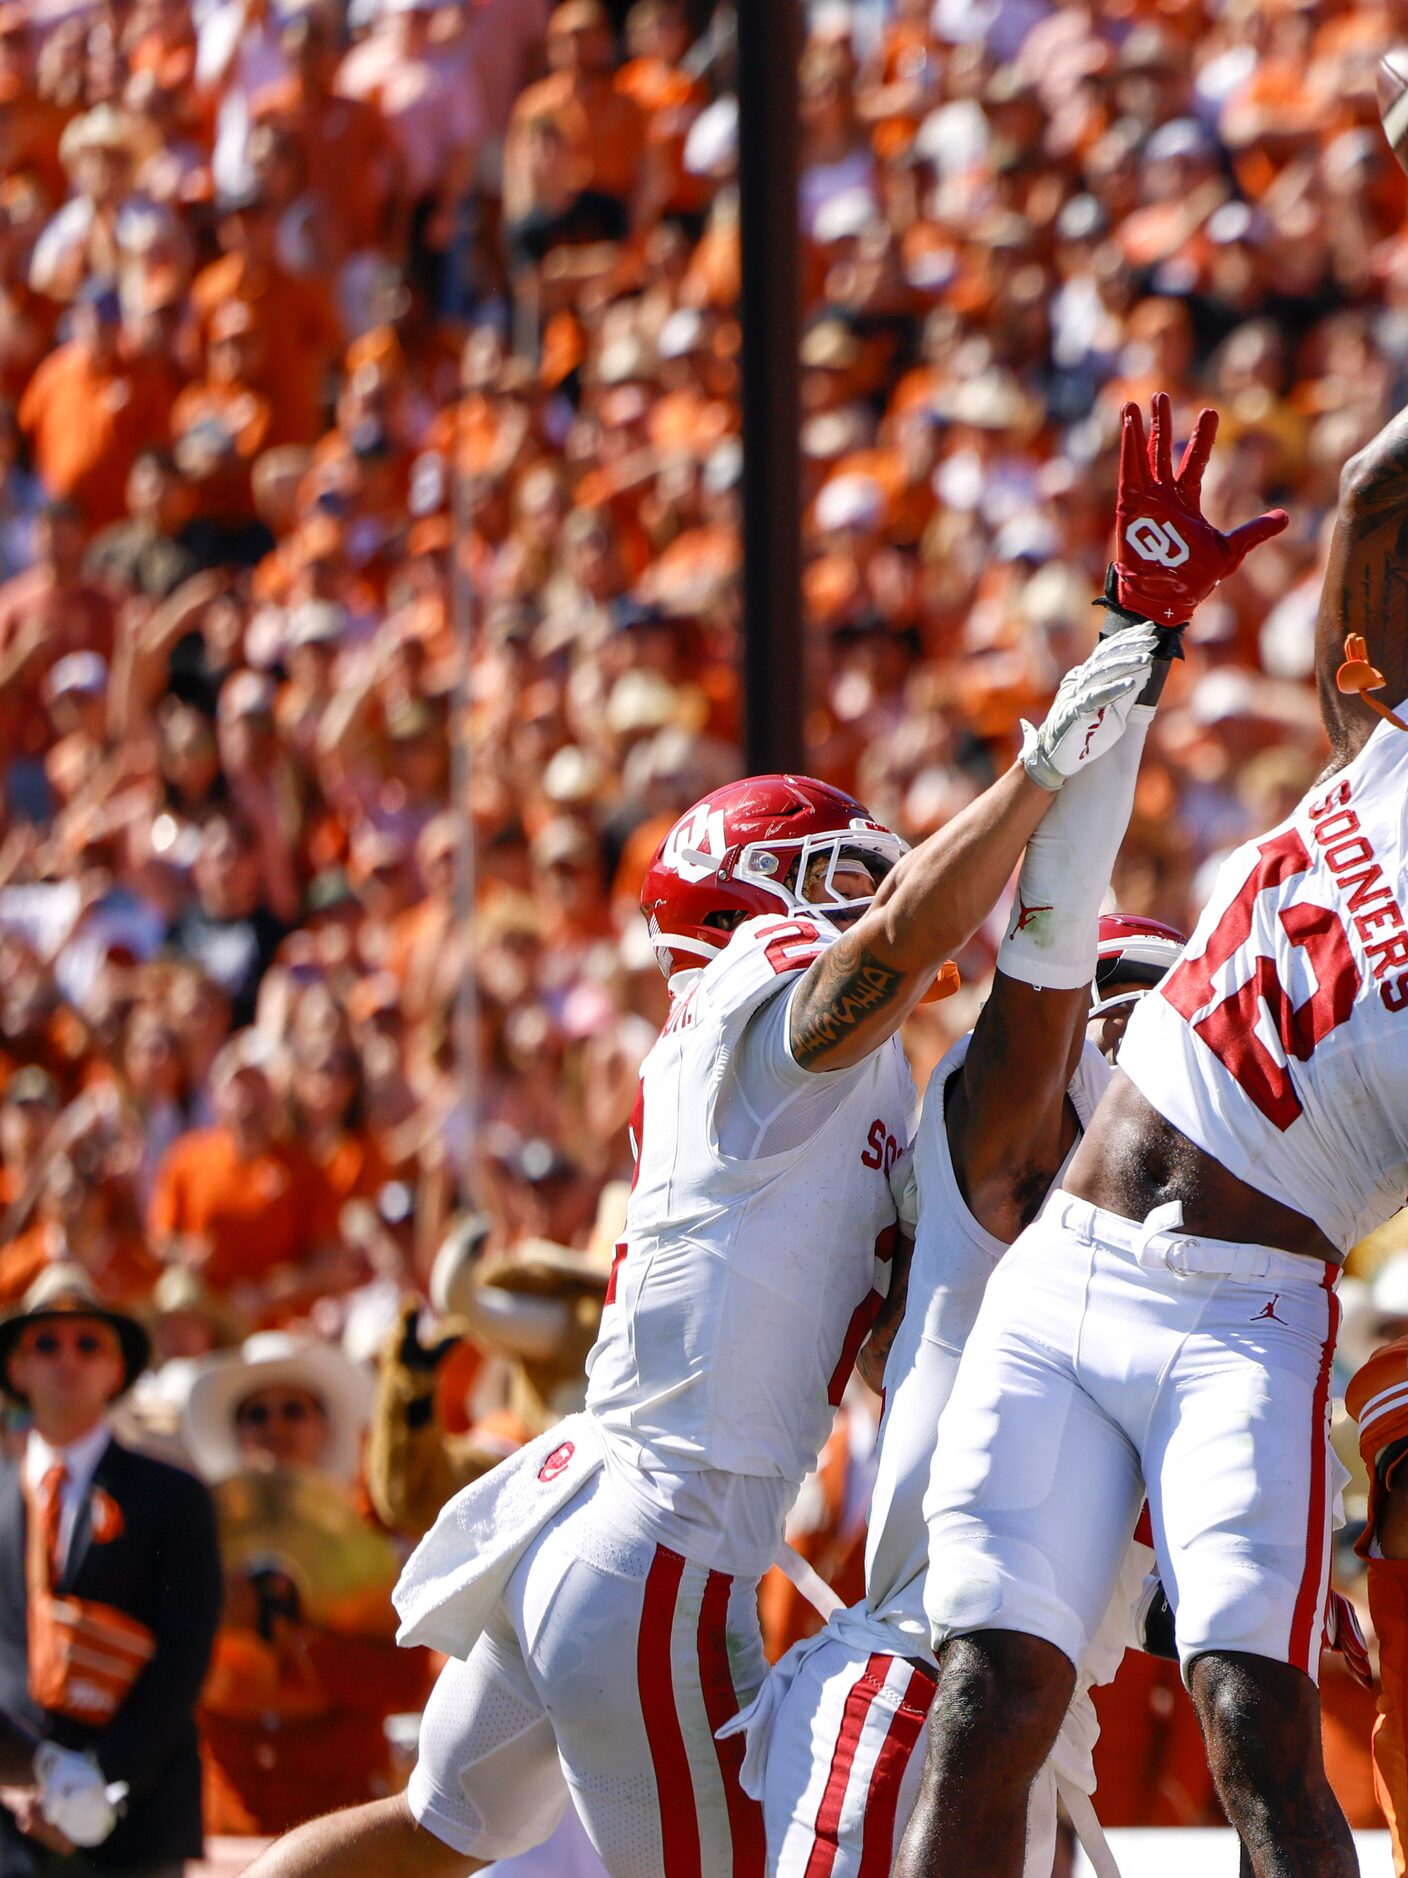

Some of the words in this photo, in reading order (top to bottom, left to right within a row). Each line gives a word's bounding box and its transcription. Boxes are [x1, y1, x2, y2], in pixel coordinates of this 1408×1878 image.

[1126, 517, 1190, 568] OU
[754, 920, 822, 974] 2
[1161, 828, 1361, 1132] 12
